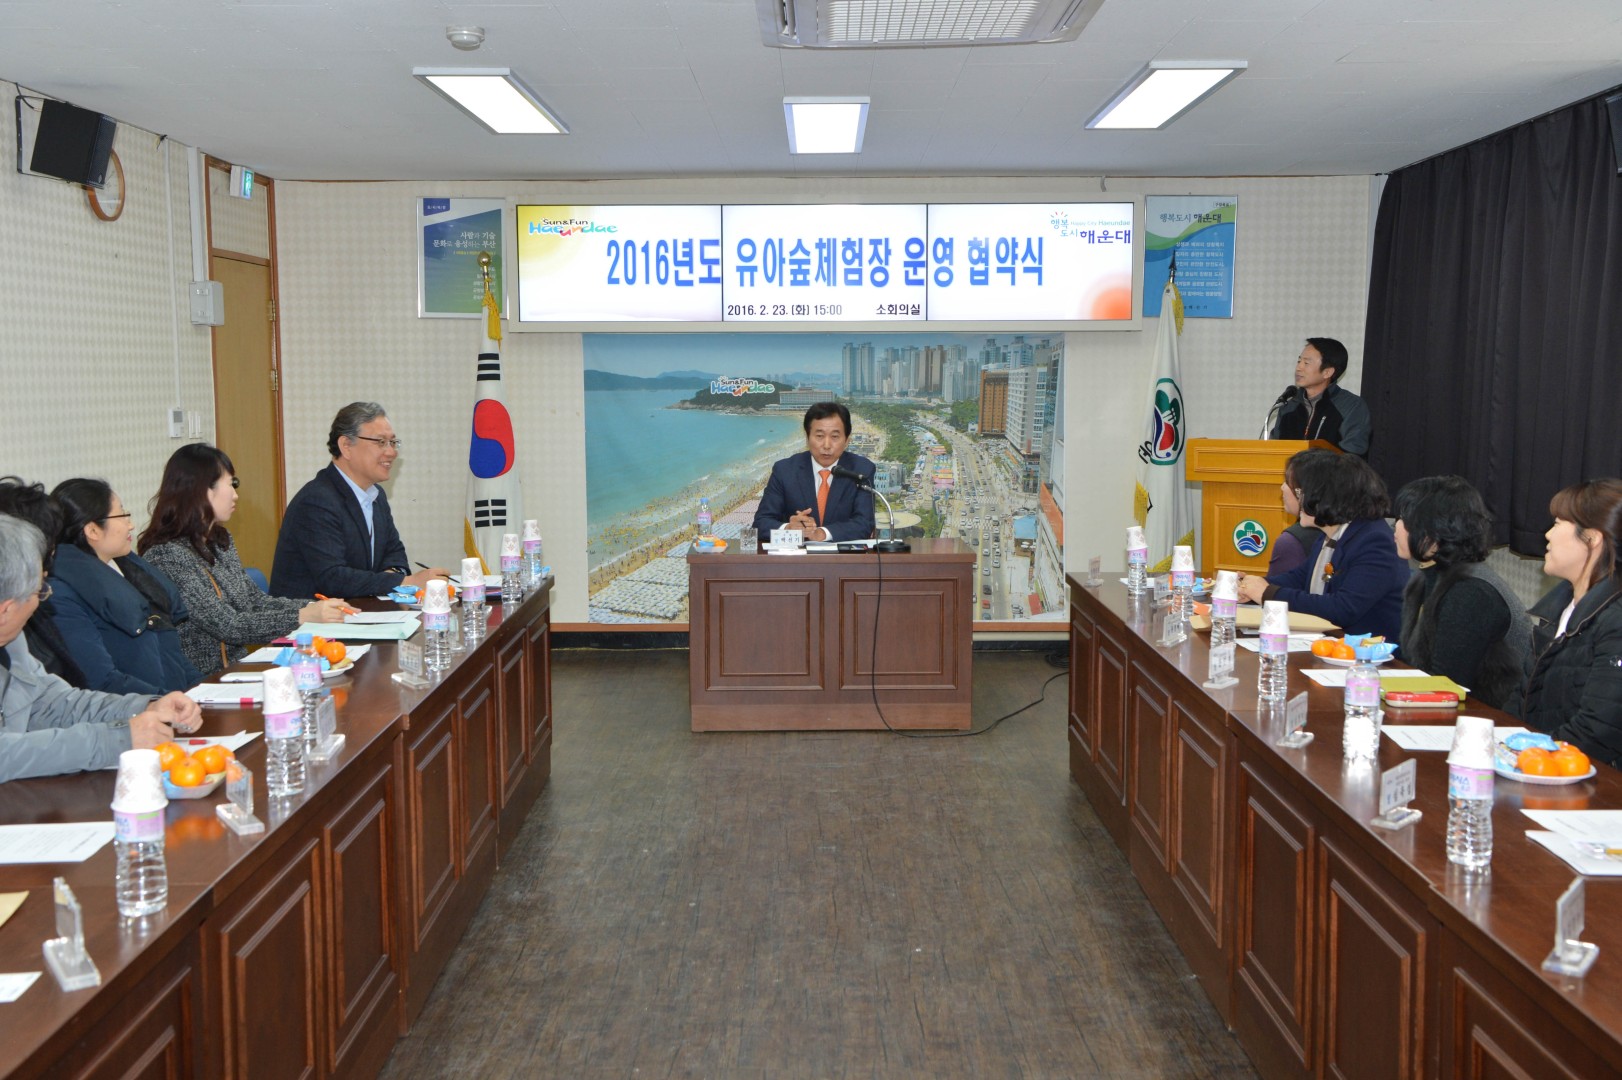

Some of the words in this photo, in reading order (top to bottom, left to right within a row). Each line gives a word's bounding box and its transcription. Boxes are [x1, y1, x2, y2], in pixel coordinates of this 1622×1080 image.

[1050, 219, 1069, 230] 행복
[1160, 213, 1191, 222] 행복도시
[1193, 213, 1222, 223] 해운대
[528, 221, 618, 236] Haeundae
[460, 231, 480, 240] 사람과
[482, 231, 496, 240] 기술
[1060, 228, 1078, 237] 도시
[1079, 230, 1131, 244] 해운대
[481, 240, 497, 249] 부산
[607, 238, 721, 287] 2016년도
[736, 237, 892, 288] 유아숲체험장
[903, 237, 954, 288] 운영
[967, 237, 1043, 287] 협약식
[727, 304, 757, 316] 2016.
[760, 304, 769, 316] 2.
[772, 304, 789, 316] 23.
[791, 303, 810, 316] (화)
[814, 304, 842, 316] 15:00
[875, 303, 921, 316] 소회의실
[710, 381, 775, 396] Haeundae
